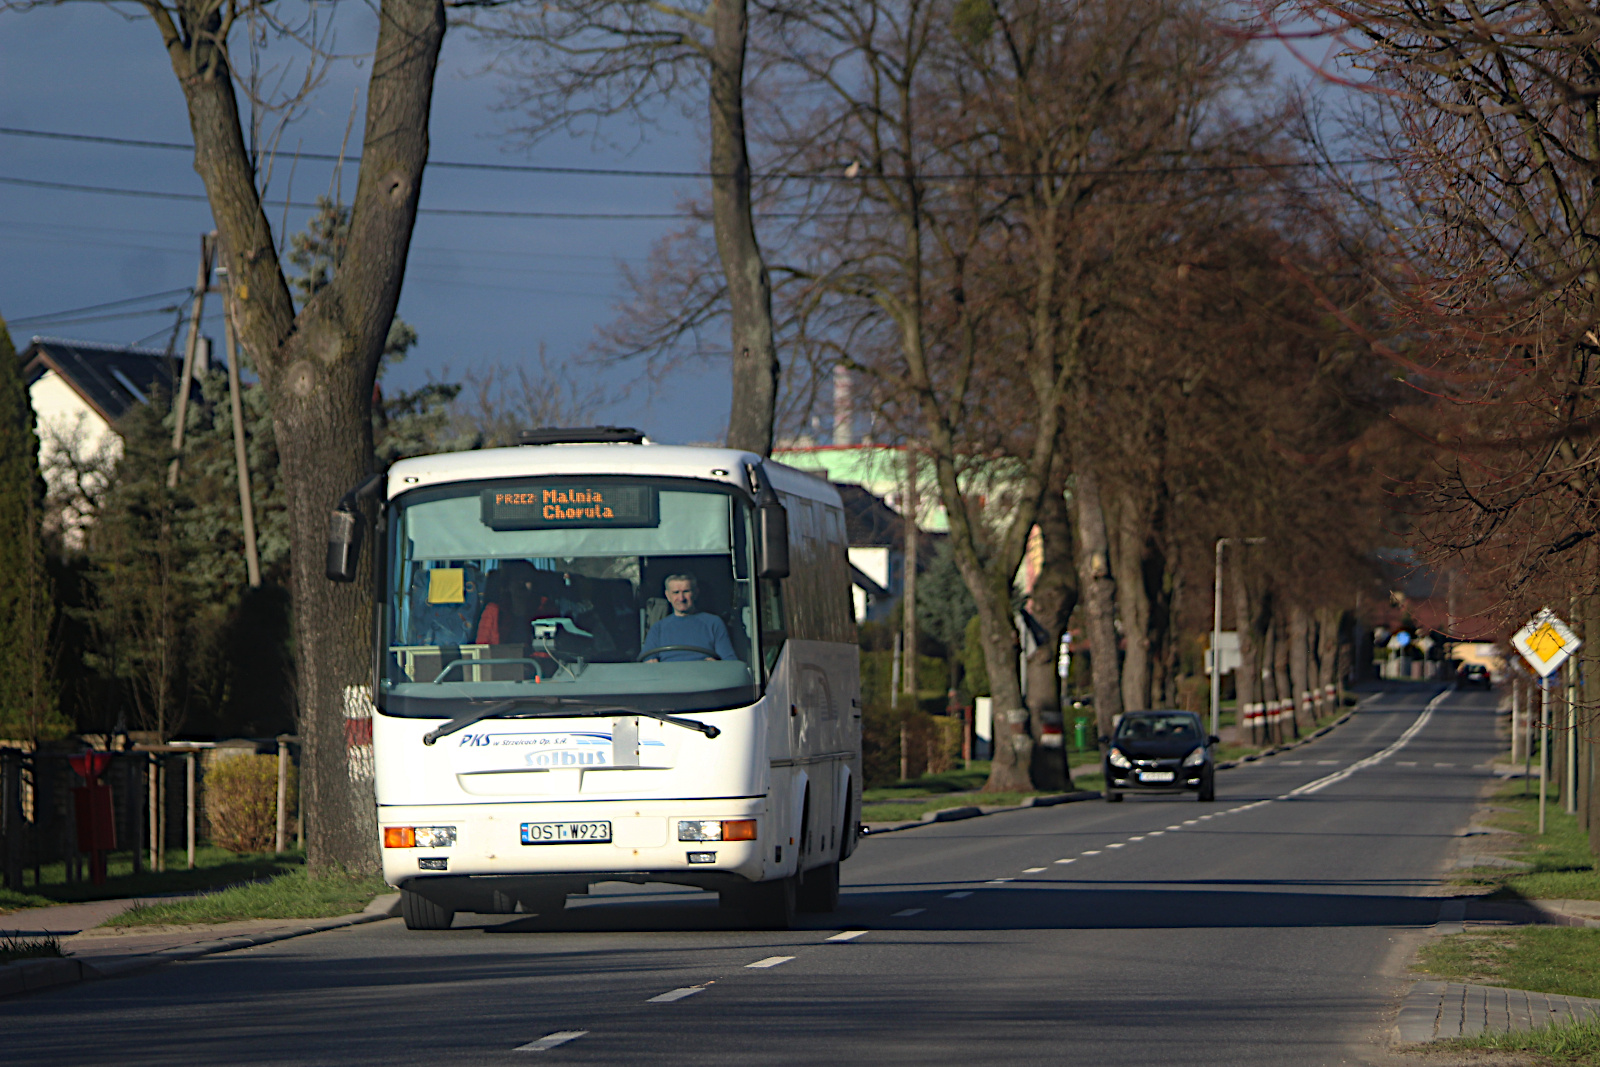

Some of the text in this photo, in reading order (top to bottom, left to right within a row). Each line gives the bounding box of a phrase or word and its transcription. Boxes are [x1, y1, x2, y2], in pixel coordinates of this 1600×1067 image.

[542, 489, 603, 504] Malnia
[542, 504, 615, 520] Chorula
[459, 733, 491, 748] PKS
[531, 823, 607, 840] OST W923
